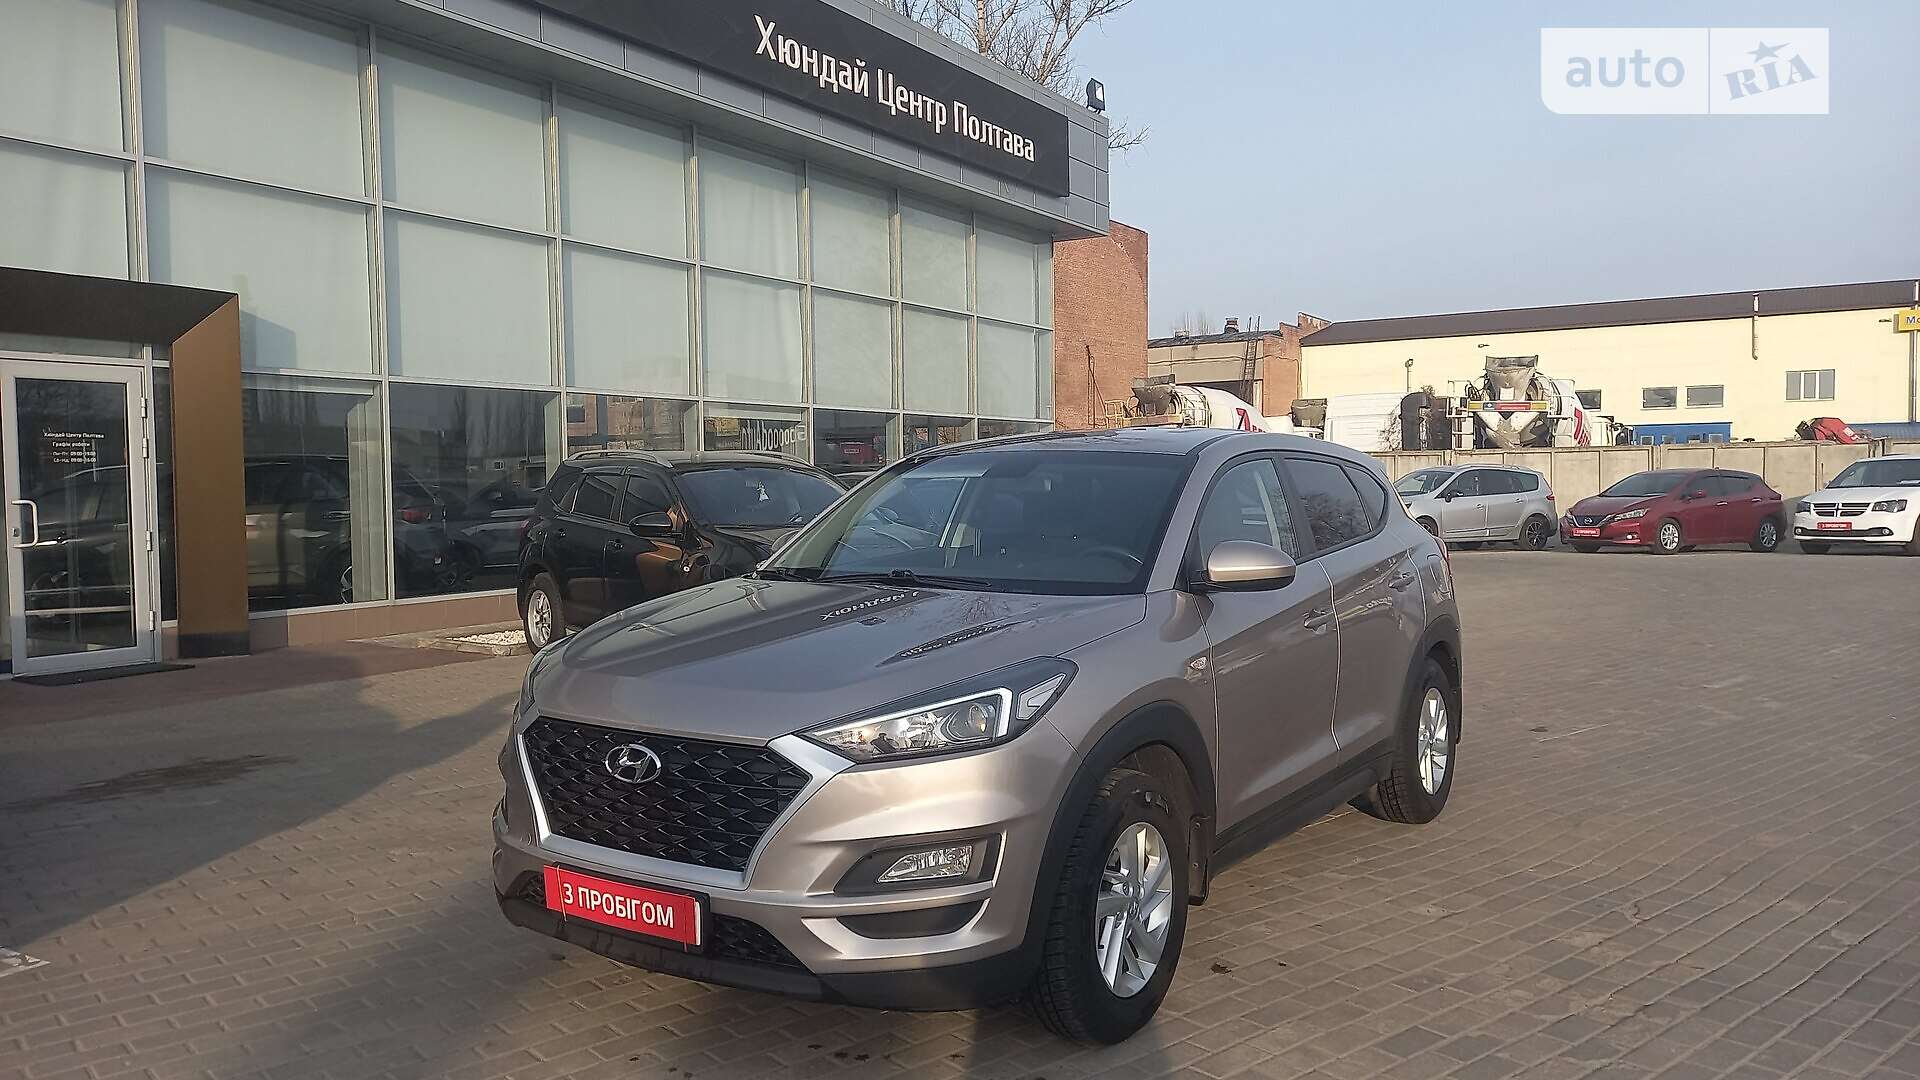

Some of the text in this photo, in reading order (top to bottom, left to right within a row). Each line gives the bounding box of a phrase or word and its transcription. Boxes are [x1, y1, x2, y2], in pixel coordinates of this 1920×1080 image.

[753, 15, 1036, 162] Хюндай Центр Полтава
[562, 883, 674, 928] З ПРОБІГОМ
